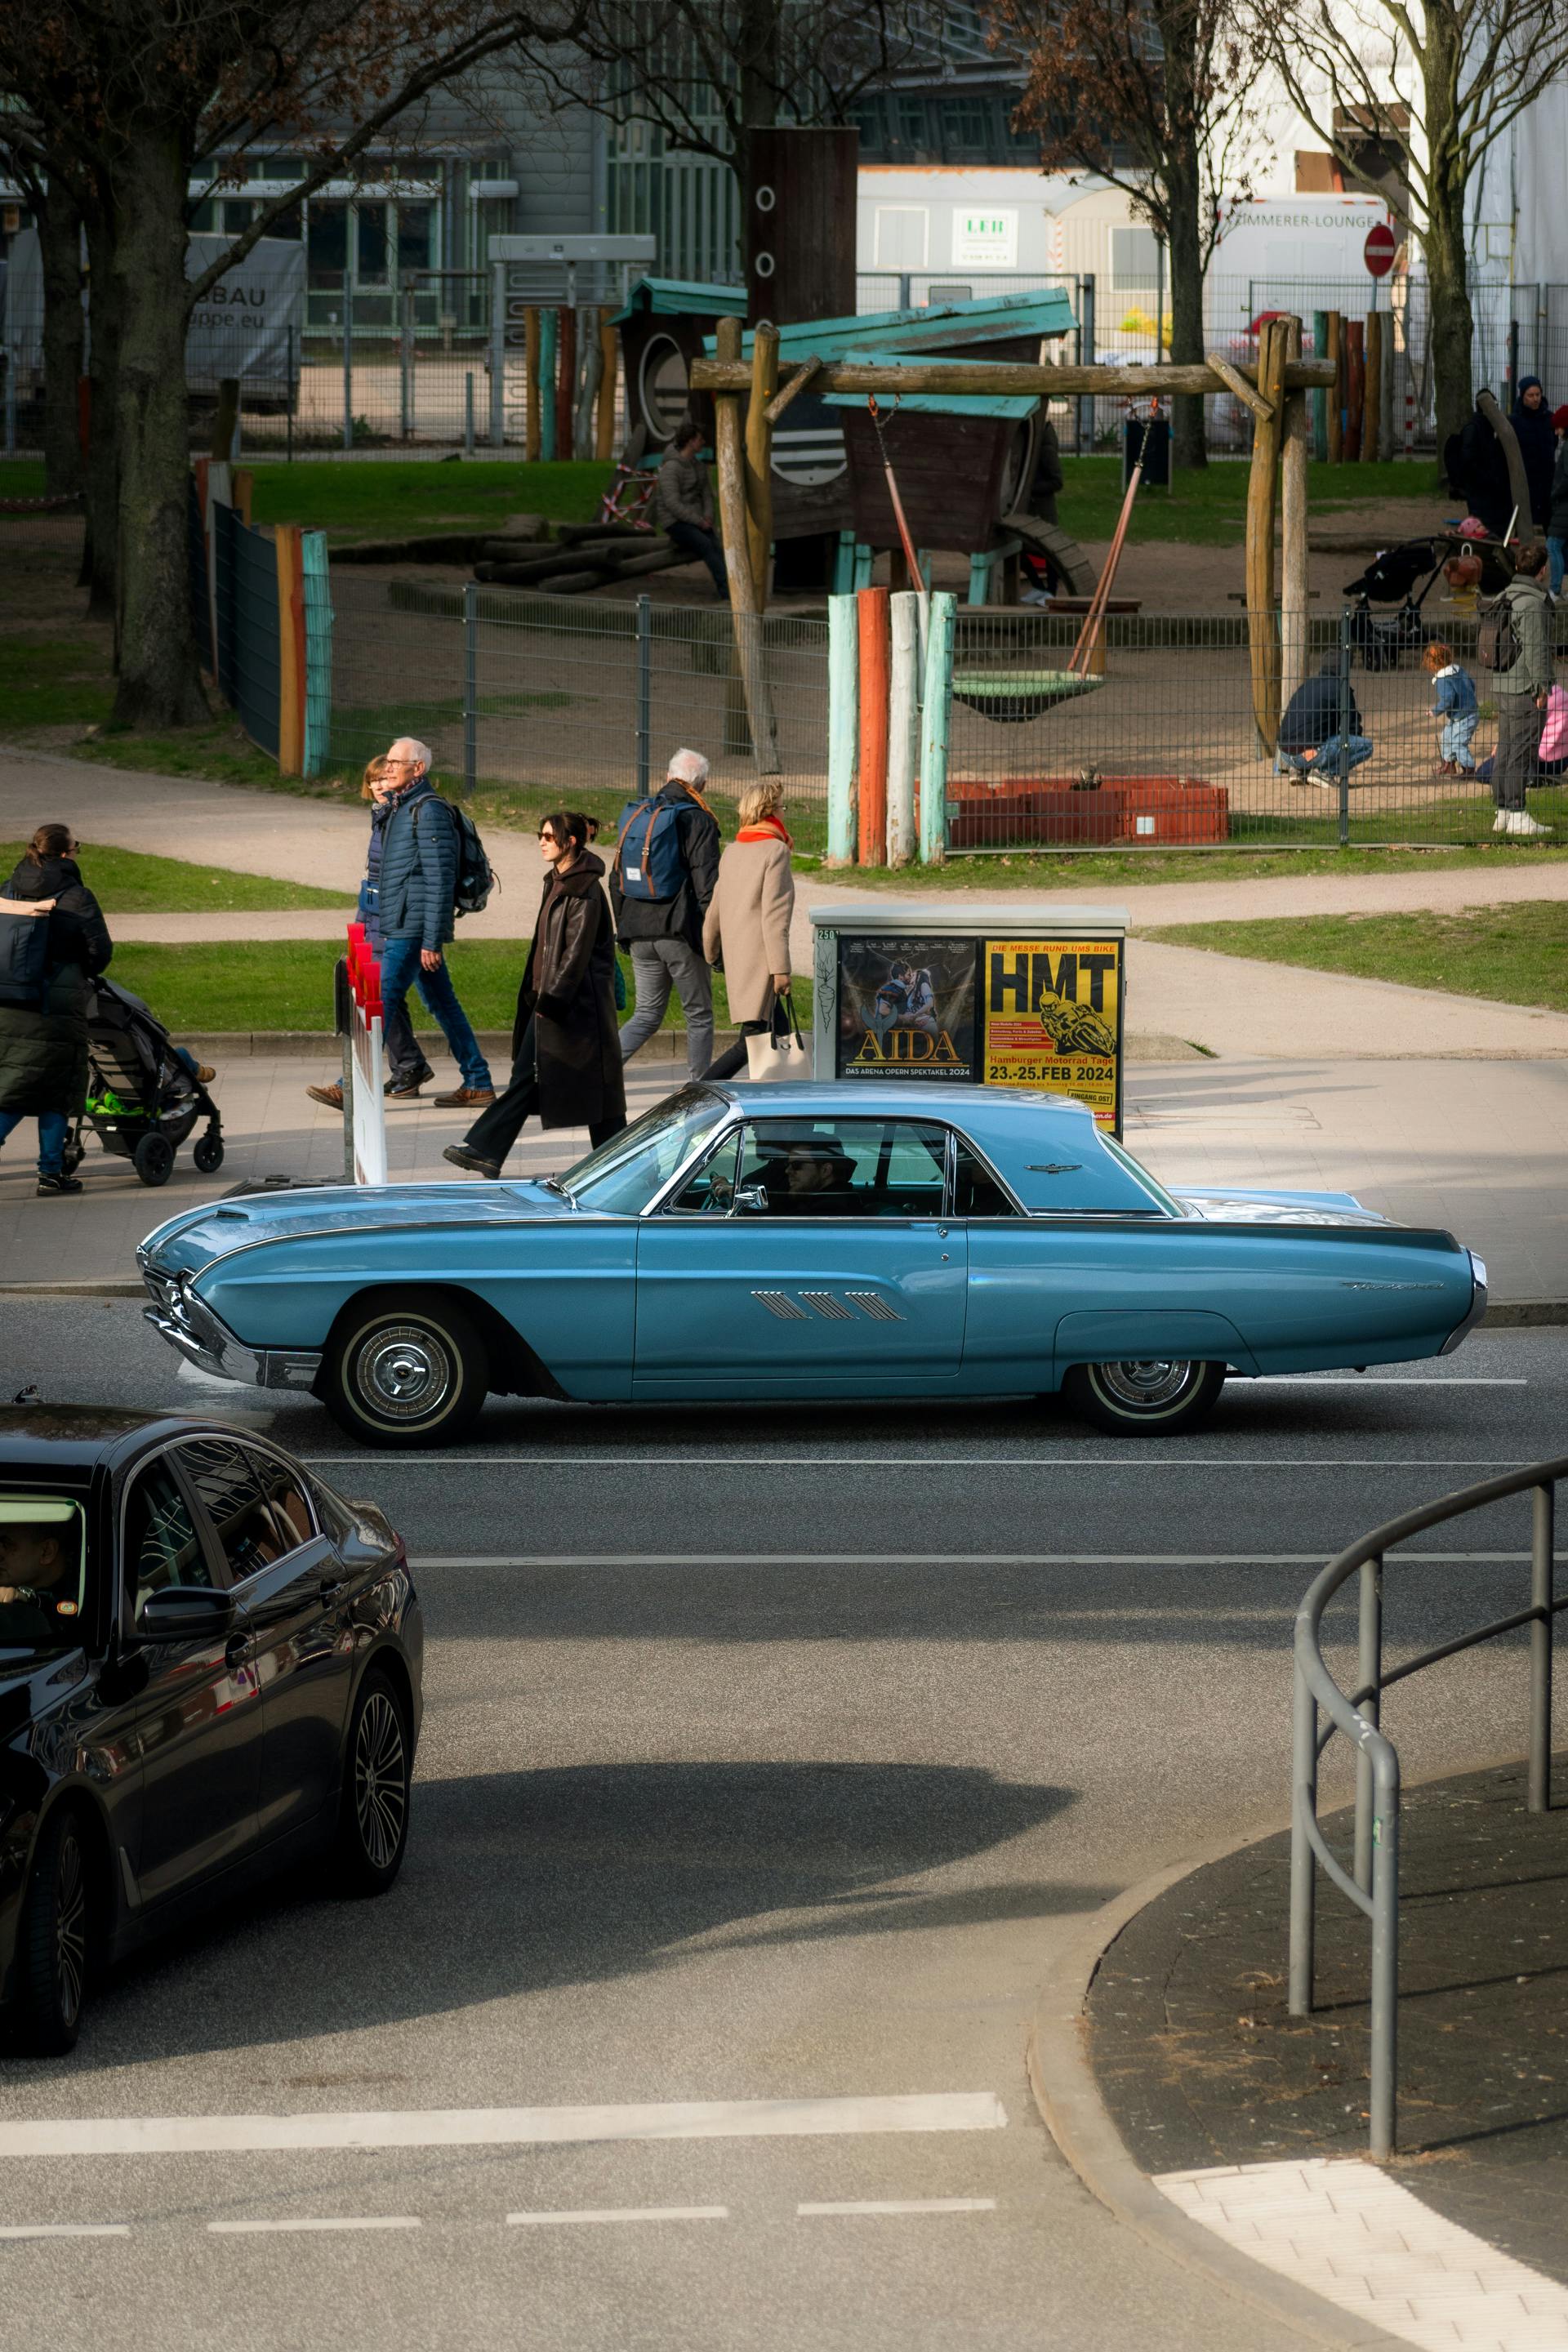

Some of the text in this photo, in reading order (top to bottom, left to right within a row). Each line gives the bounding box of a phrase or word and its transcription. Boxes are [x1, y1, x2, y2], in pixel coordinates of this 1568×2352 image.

[991, 953, 1115, 1013] HMT
[854, 1028, 961, 1061] AIDA
[990, 1056, 1114, 1067] Hamburger Motorrad Tage
[990, 1066, 1114, 1081] 23.-25.FEB 2024
[1071, 1093, 1097, 1102] EINGANG
